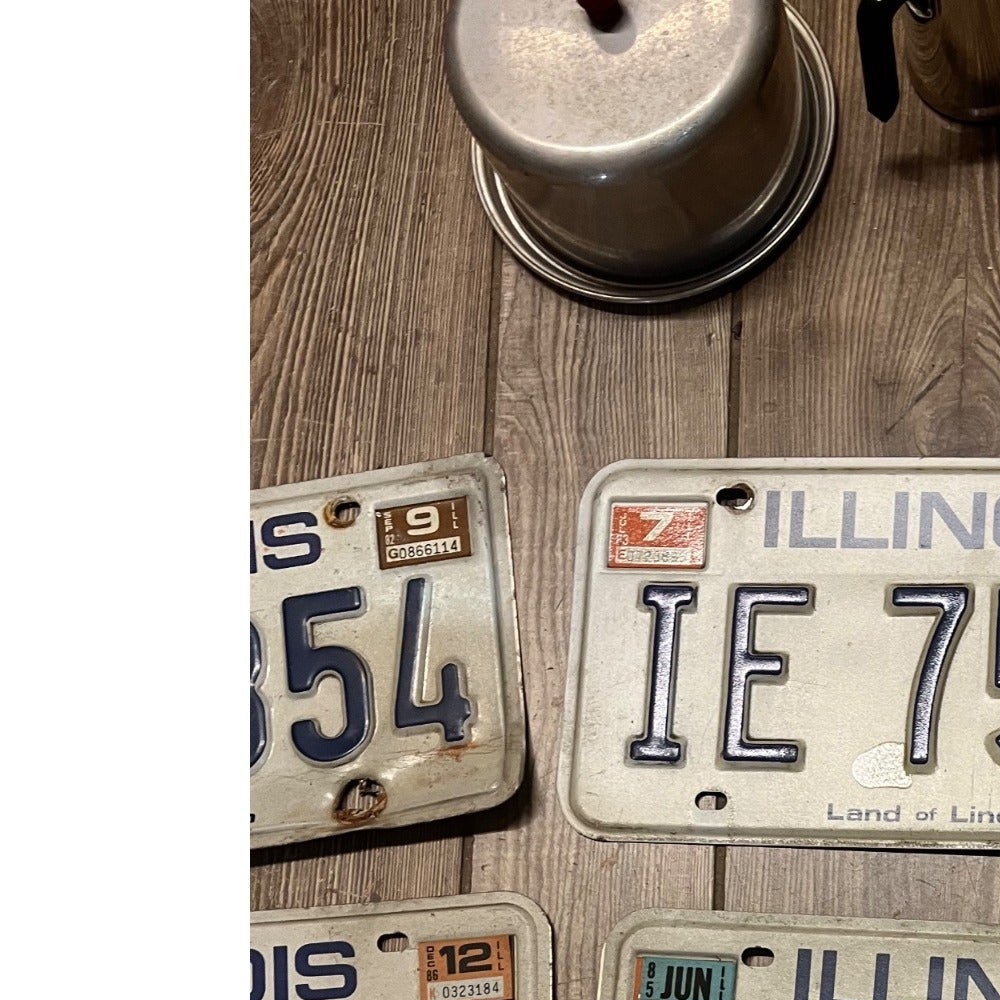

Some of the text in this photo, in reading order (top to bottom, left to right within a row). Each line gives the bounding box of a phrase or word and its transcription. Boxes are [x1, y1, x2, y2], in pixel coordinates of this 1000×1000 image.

[406, 505, 440, 536] 9
[641, 511, 674, 542] 7
[388, 540, 458, 559] G0866114
[250, 578, 471, 767] 54
[629, 585, 810, 763] IE
[827, 803, 900, 822] Land
[915, 808, 937, 821] of
[439, 942, 493, 975] 12
